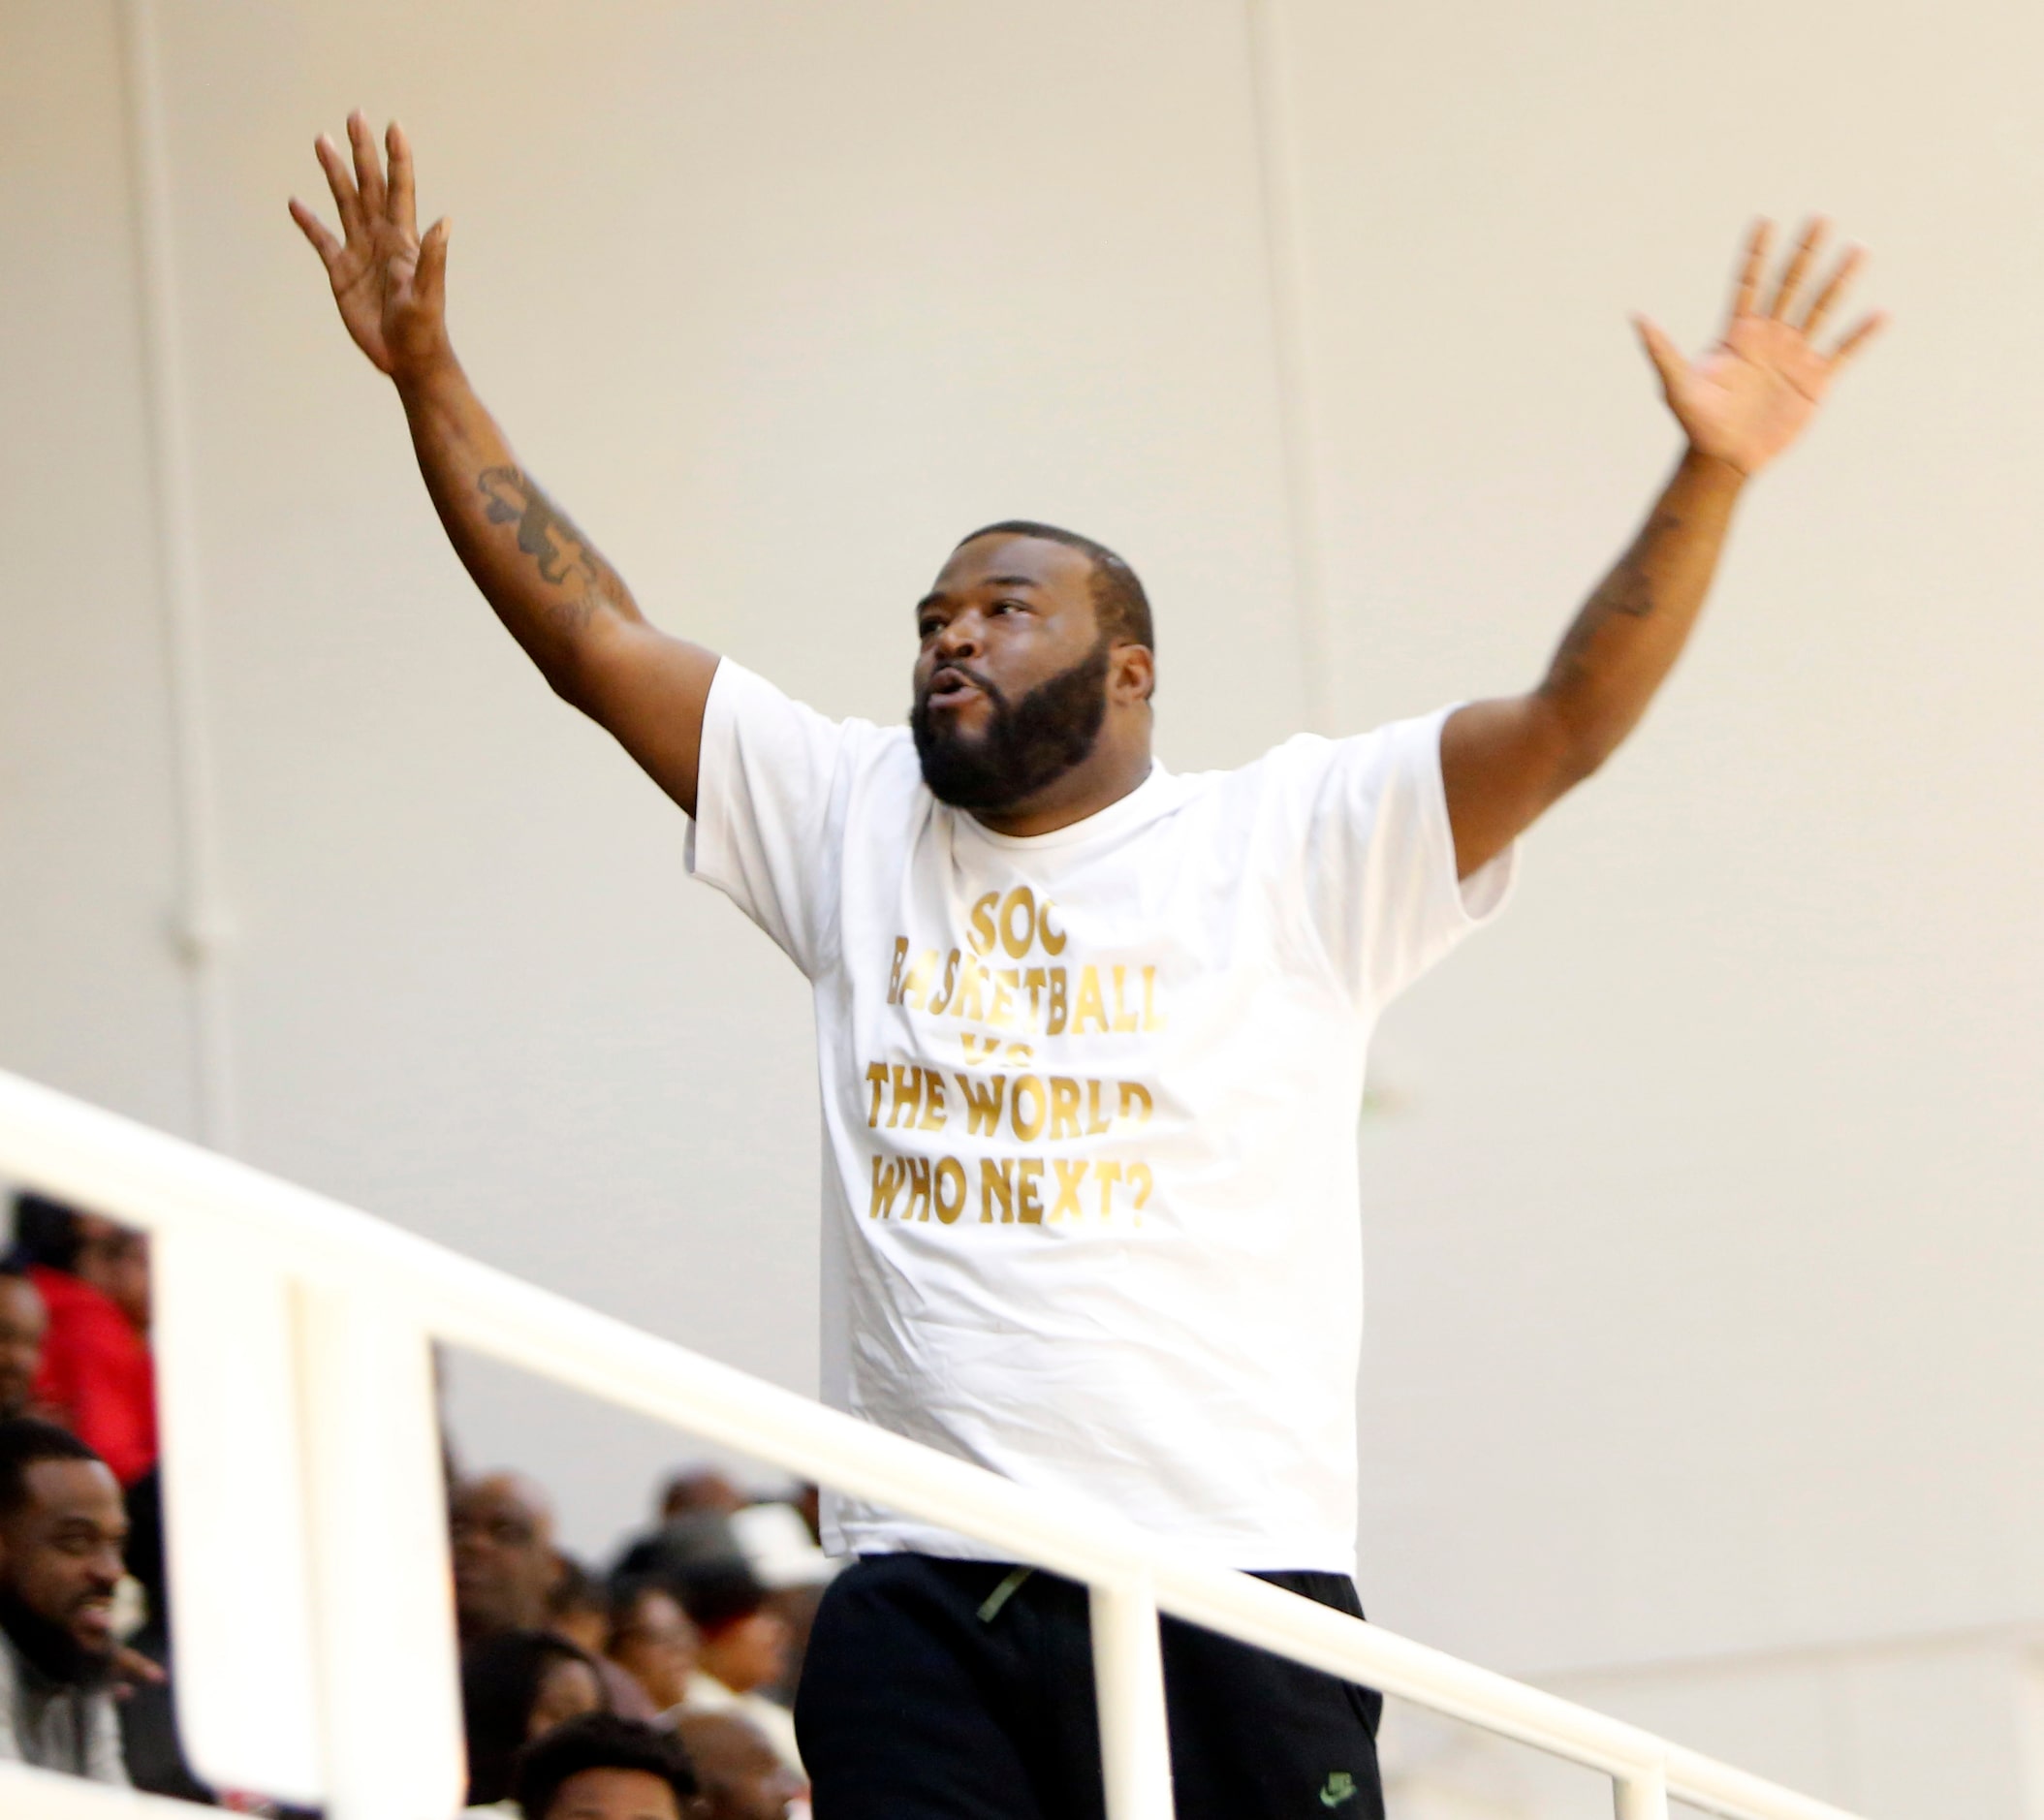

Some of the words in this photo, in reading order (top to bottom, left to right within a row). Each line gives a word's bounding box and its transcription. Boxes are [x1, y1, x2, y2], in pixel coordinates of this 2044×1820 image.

[966, 885, 1067, 959] SOC
[887, 935, 1168, 1036] BASKETBALL
[865, 1061, 948, 1132] THE
[954, 1073, 1154, 1142] WORLD
[869, 1154, 967, 1225] WHO
[979, 1157, 1154, 1229] NEXT?
